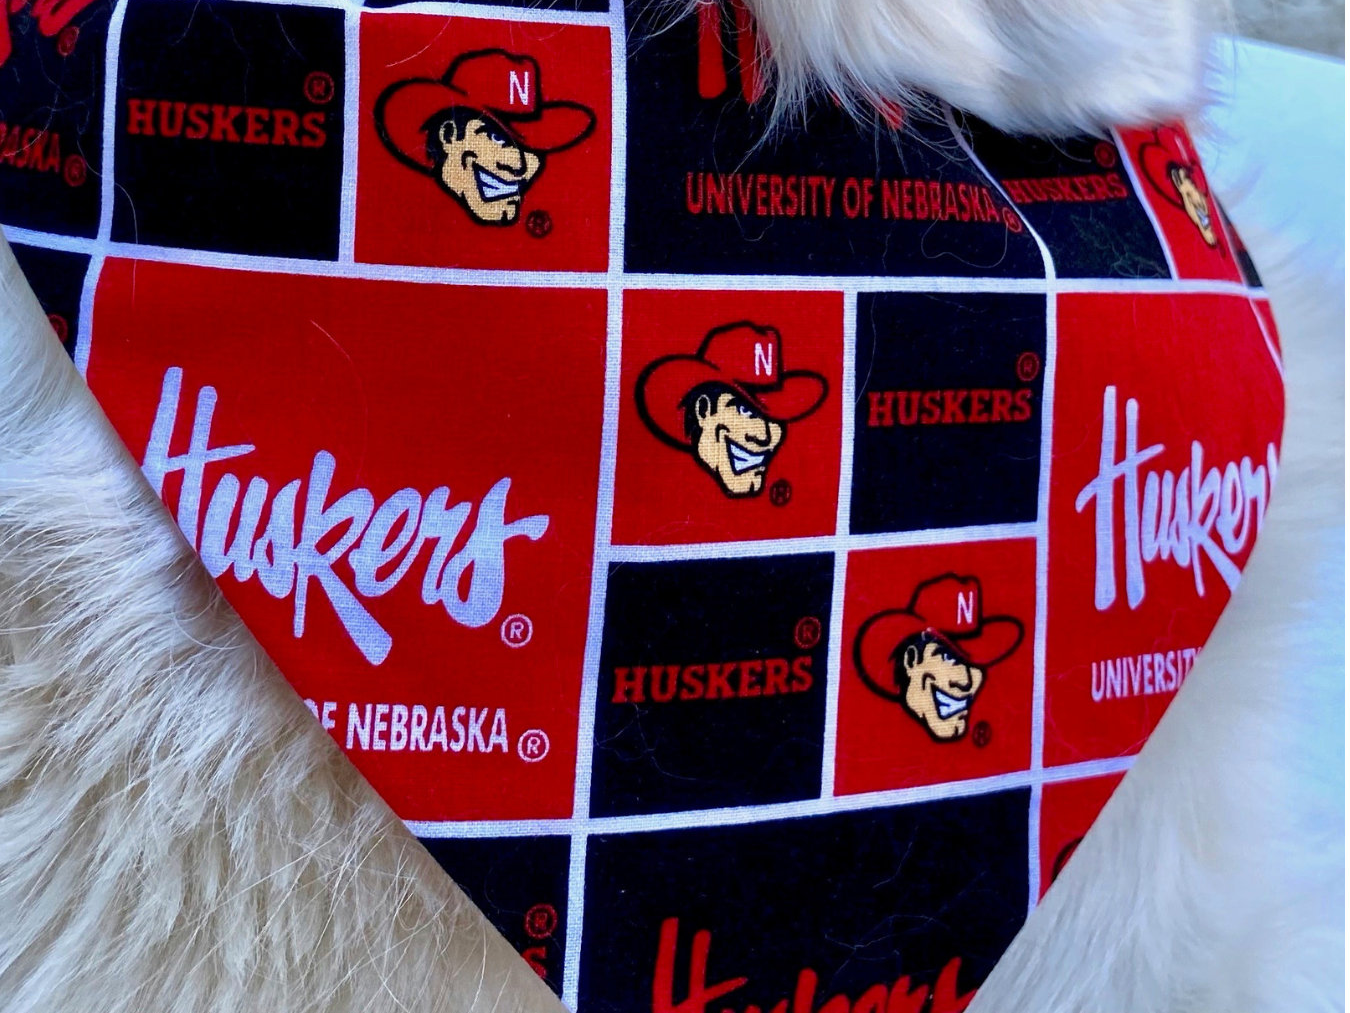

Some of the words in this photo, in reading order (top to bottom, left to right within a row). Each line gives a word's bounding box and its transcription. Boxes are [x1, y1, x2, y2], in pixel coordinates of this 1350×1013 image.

[507, 70, 531, 107] N
[126, 97, 328, 149] HUSKERS
[686, 171, 838, 218] UNIVERSITY
[841, 177, 875, 219] OF
[881, 179, 1000, 225] NEBRASKA
[754, 341, 773, 377] N
[867, 389, 1032, 428] HUSKERS
[1075, 385, 1281, 611] Husker
[956, 588, 974, 626] N
[611, 655, 814, 706] HUSKERS
[345, 701, 509, 753] NEBRASKA
